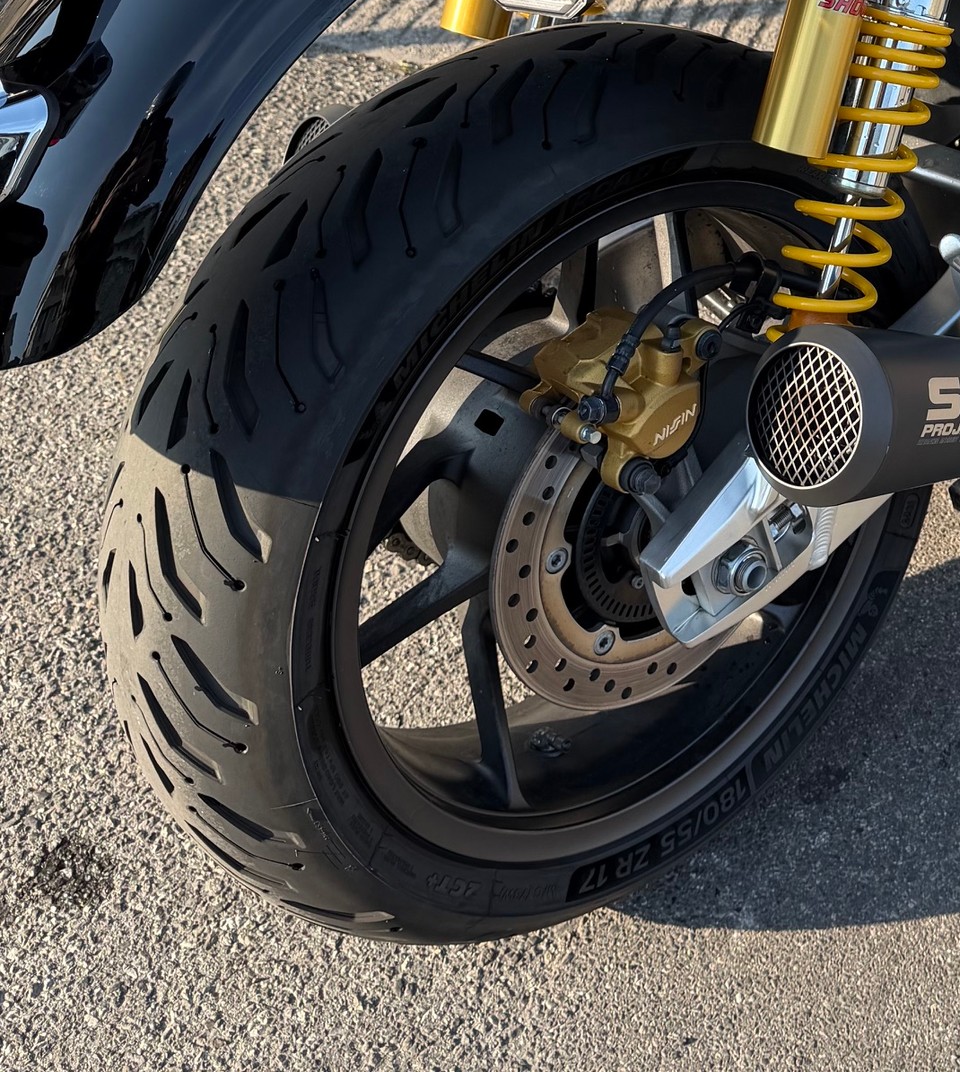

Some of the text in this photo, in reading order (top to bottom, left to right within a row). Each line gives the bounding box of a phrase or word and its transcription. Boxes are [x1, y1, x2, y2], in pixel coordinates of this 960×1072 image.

[653, 403, 697, 446] NISSIN
[763, 622, 868, 773] MICHELIN
[578, 779, 746, 894] 180/55 ZR 17
